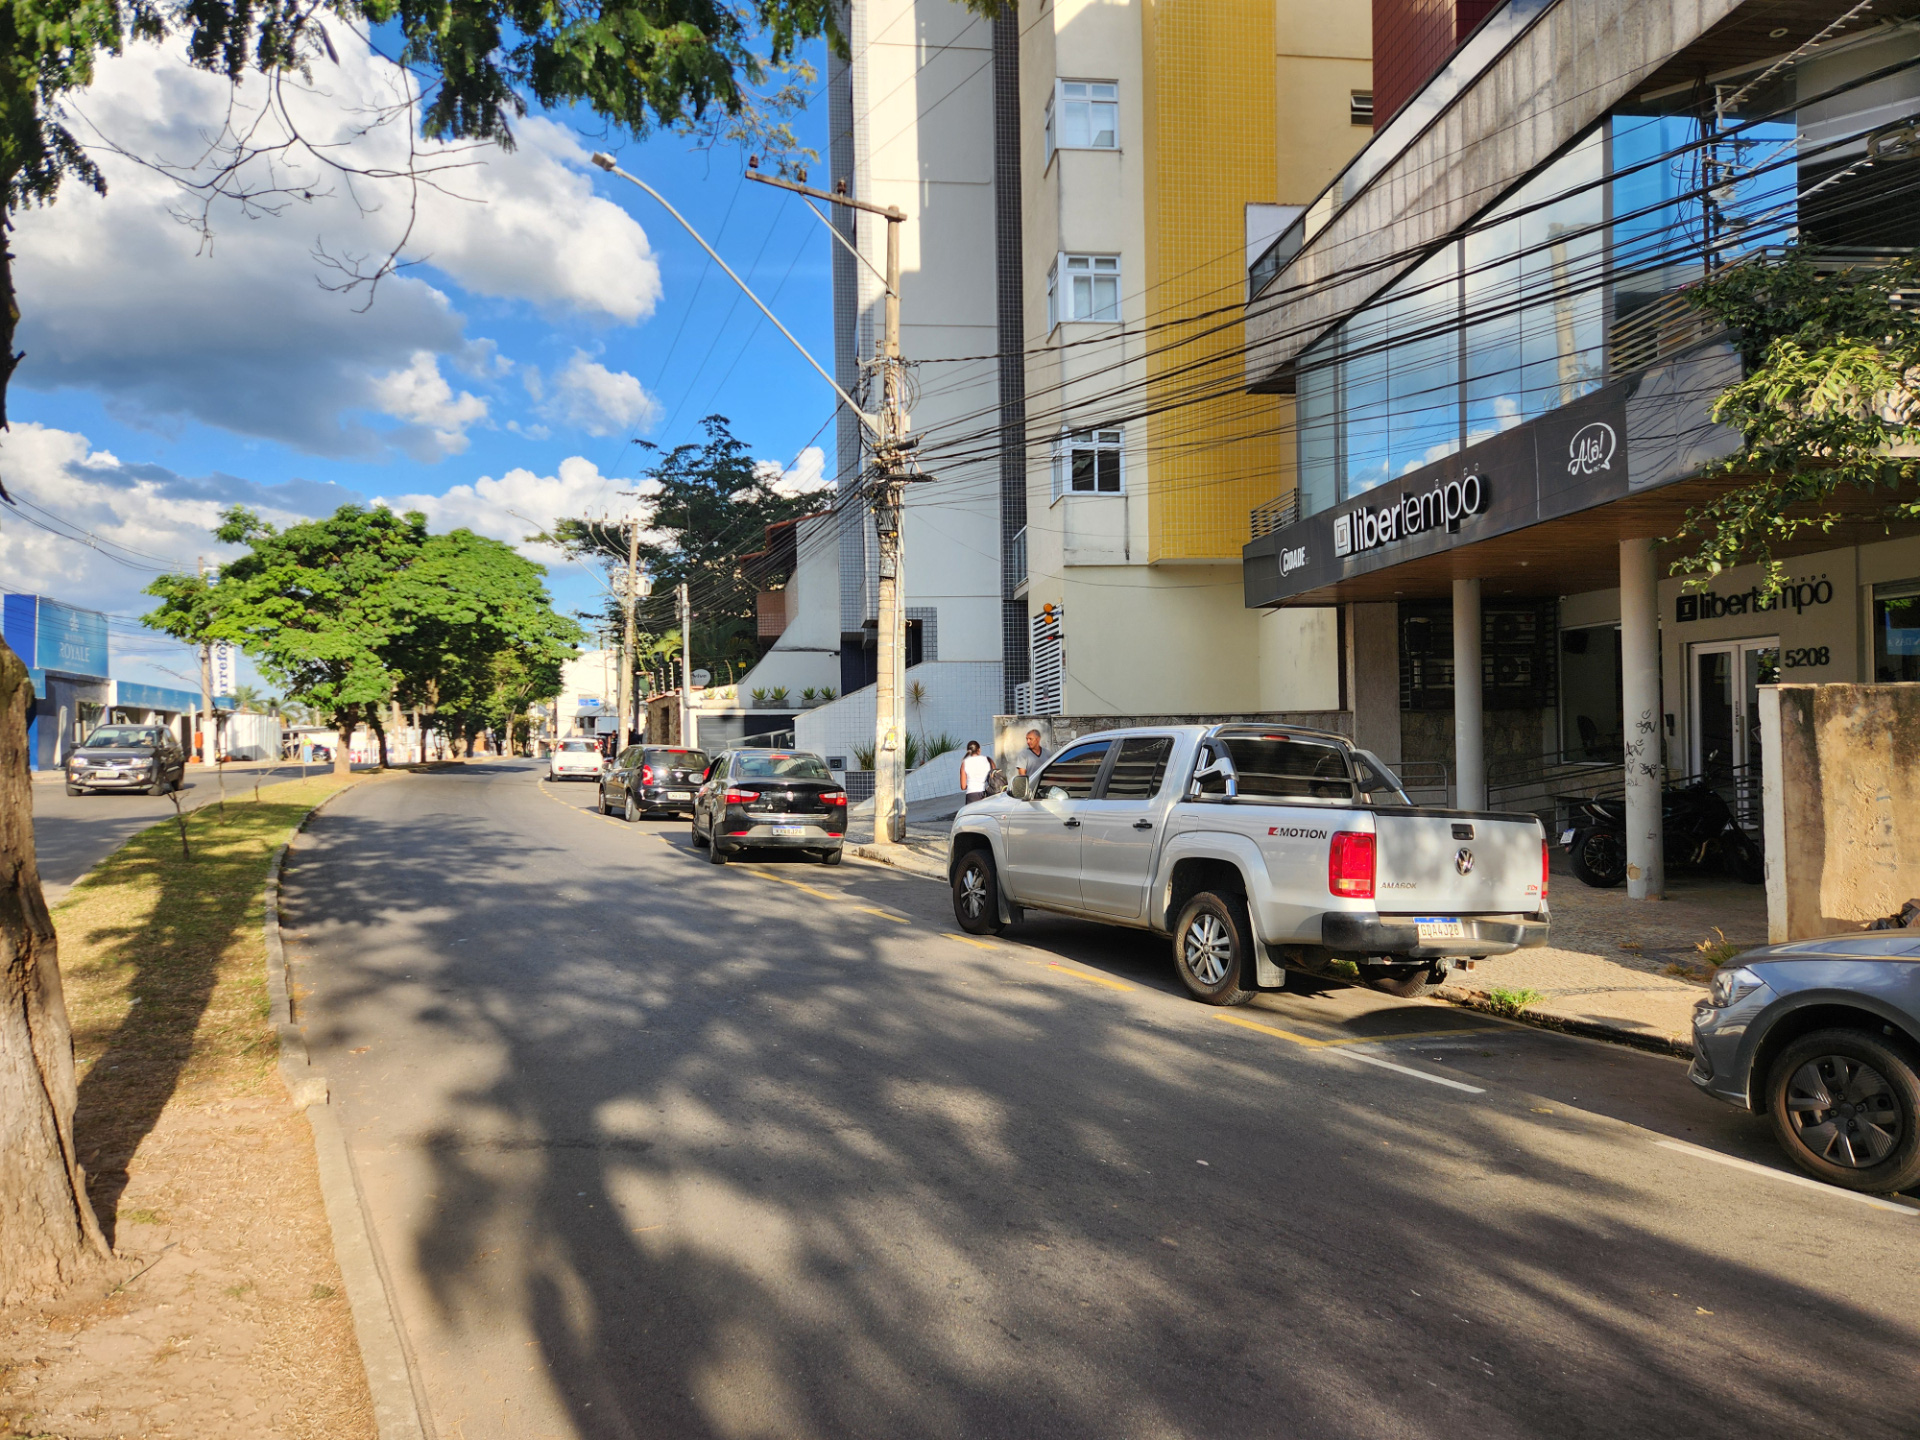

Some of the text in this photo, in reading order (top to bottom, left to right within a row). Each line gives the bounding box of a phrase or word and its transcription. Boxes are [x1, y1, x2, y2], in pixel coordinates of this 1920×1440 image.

[1353, 475, 1480, 551] libertempo
[1281, 546, 1306, 574] CIDADE
[1785, 646, 1831, 668] 5208
